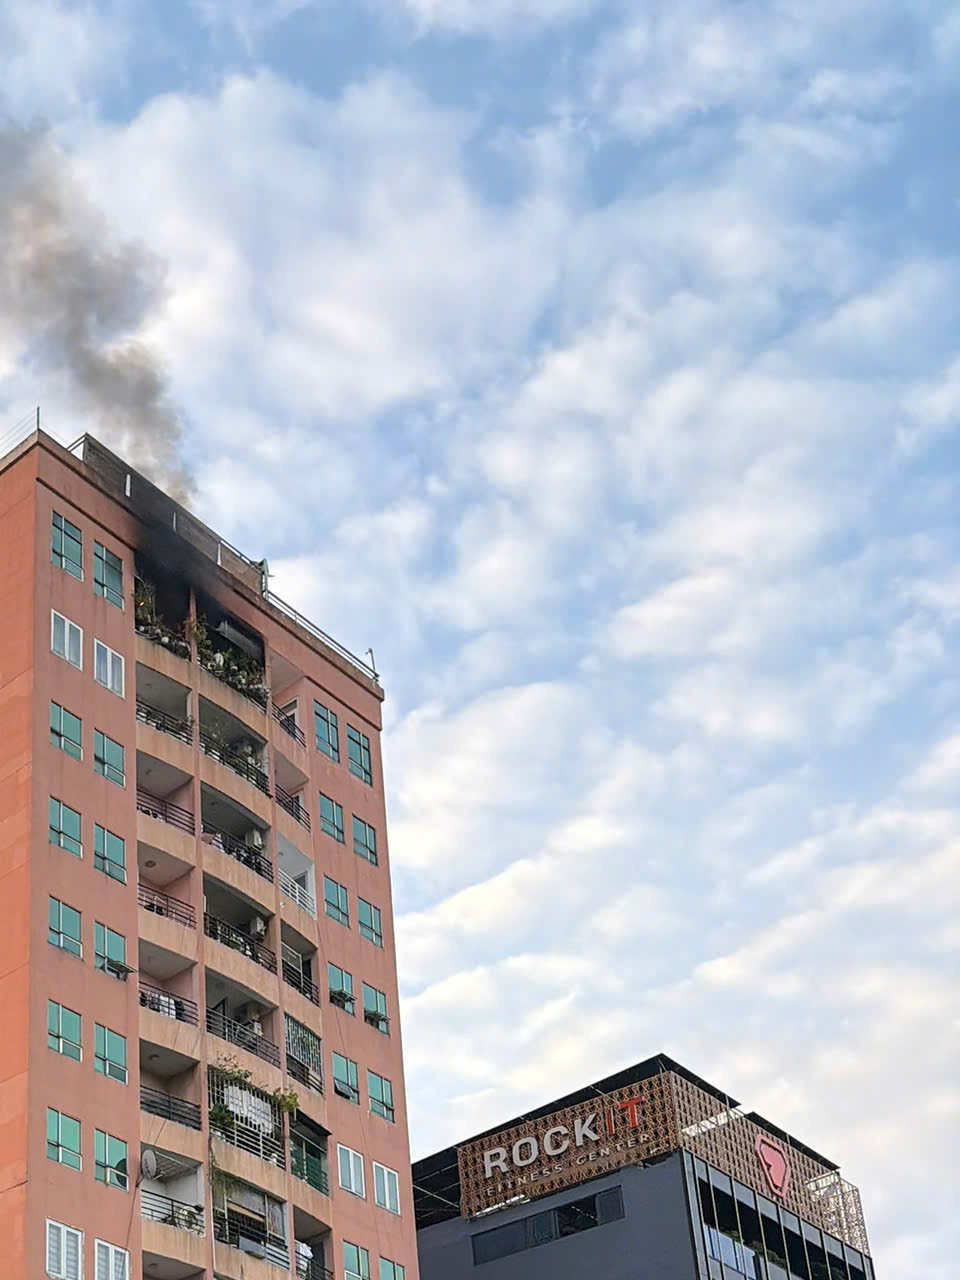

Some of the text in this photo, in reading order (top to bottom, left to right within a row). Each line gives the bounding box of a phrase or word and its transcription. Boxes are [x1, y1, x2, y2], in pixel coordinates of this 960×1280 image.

[483, 1096, 644, 1178] ROCKIT
[487, 1133, 650, 1196] FITNESS CENTER
